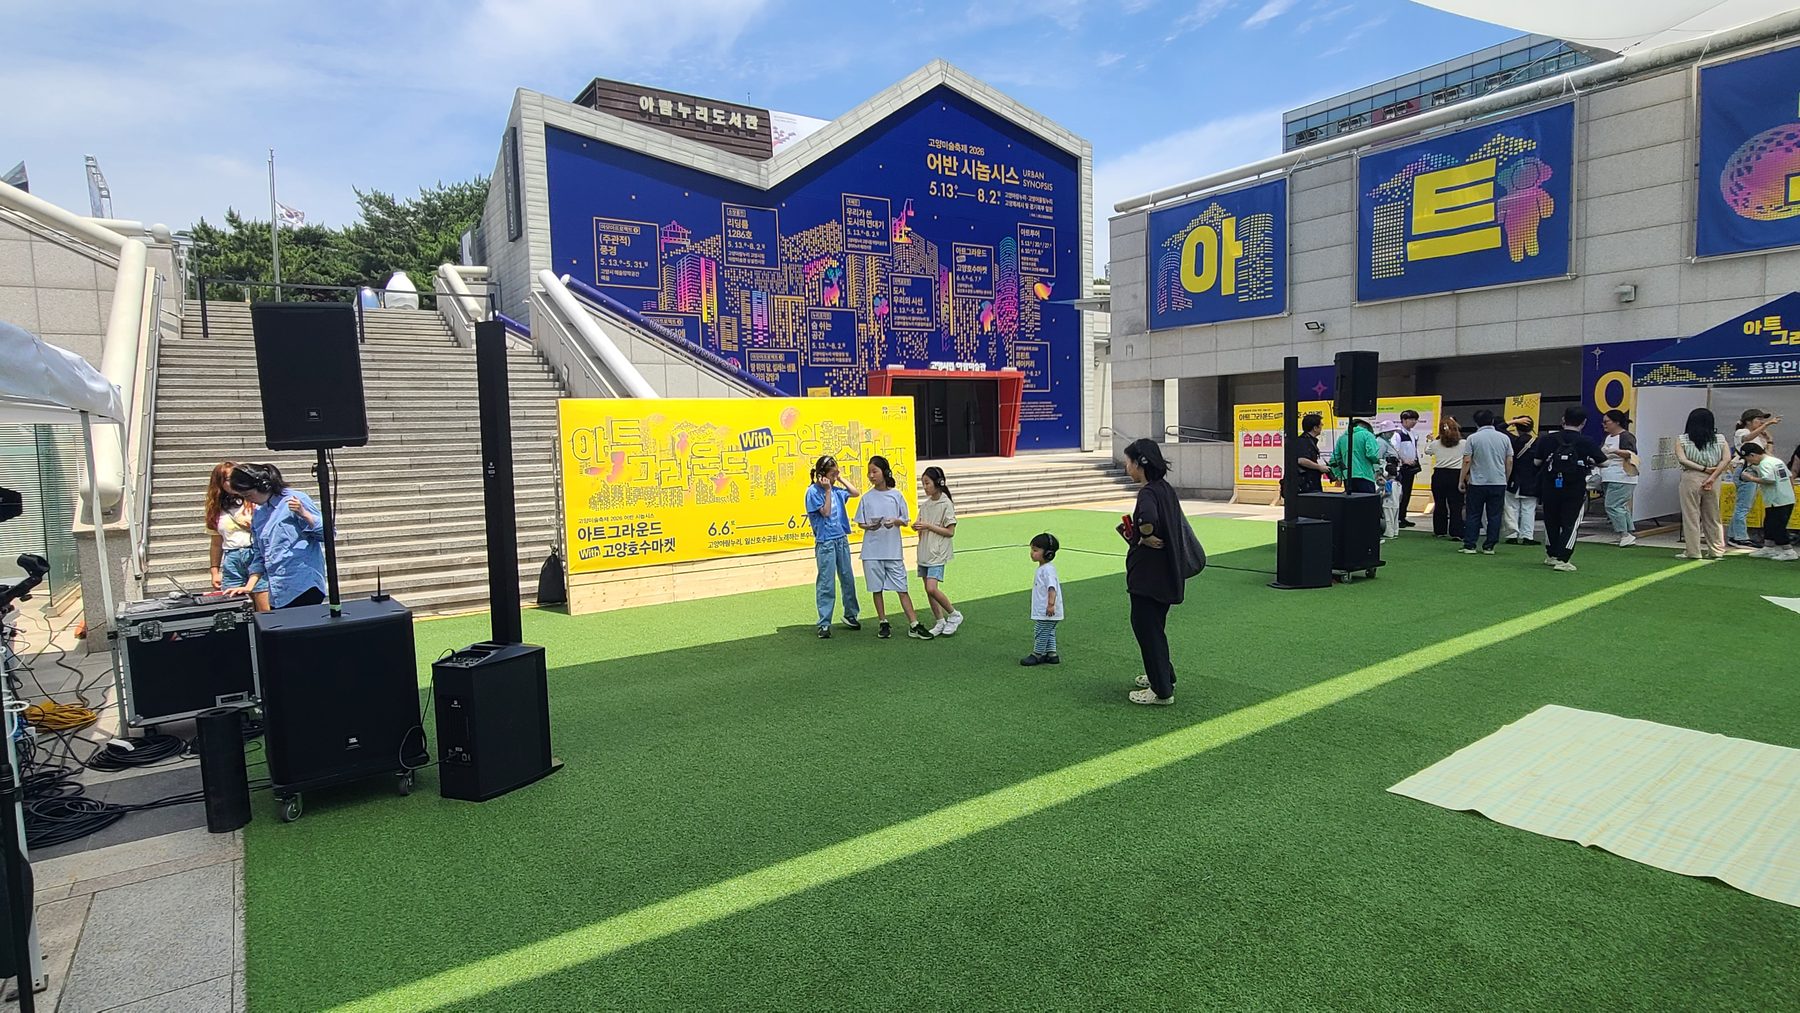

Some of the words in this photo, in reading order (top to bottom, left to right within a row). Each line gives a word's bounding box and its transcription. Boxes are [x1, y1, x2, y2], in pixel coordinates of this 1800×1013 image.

[638, 95, 759, 130] 아람누리도서관
[928, 138, 968, 154] 고양미술축제
[968, 146, 985, 156] 2026
[927, 153, 958, 176] 어반
[961, 159, 1020, 185] 시놉시스
[1022, 169, 1045, 180] URBAN
[1022, 179, 1054, 192] SYNOPSIS
[846, 207, 865, 218] 우리가
[1407, 157, 1502, 262] 트
[846, 217, 865, 228] 도시의
[865, 219, 885, 231] 연대기
[600, 233, 631, 247] (주관적)
[727, 229, 753, 240] 1286호
[600, 244, 617, 256] 풍경
[955, 246, 987, 257] 아트그라운드
[1181, 215, 1243, 297] 아
[956, 263, 987, 274] 고양호수마켓
[893, 295, 911, 306] 우리의
[911, 297, 924, 307] 시선
[1743, 315, 1782, 335] 아트
[811, 330, 825, 341] 공간
[1748, 360, 1800, 375] 종합안
[740, 428, 773, 450] With
[577, 521, 664, 543] 아트그라운드
[744, 534, 779, 545] 일산호수공원
[580, 548, 600, 559] With
[602, 537, 676, 559] 고양호수마켓
